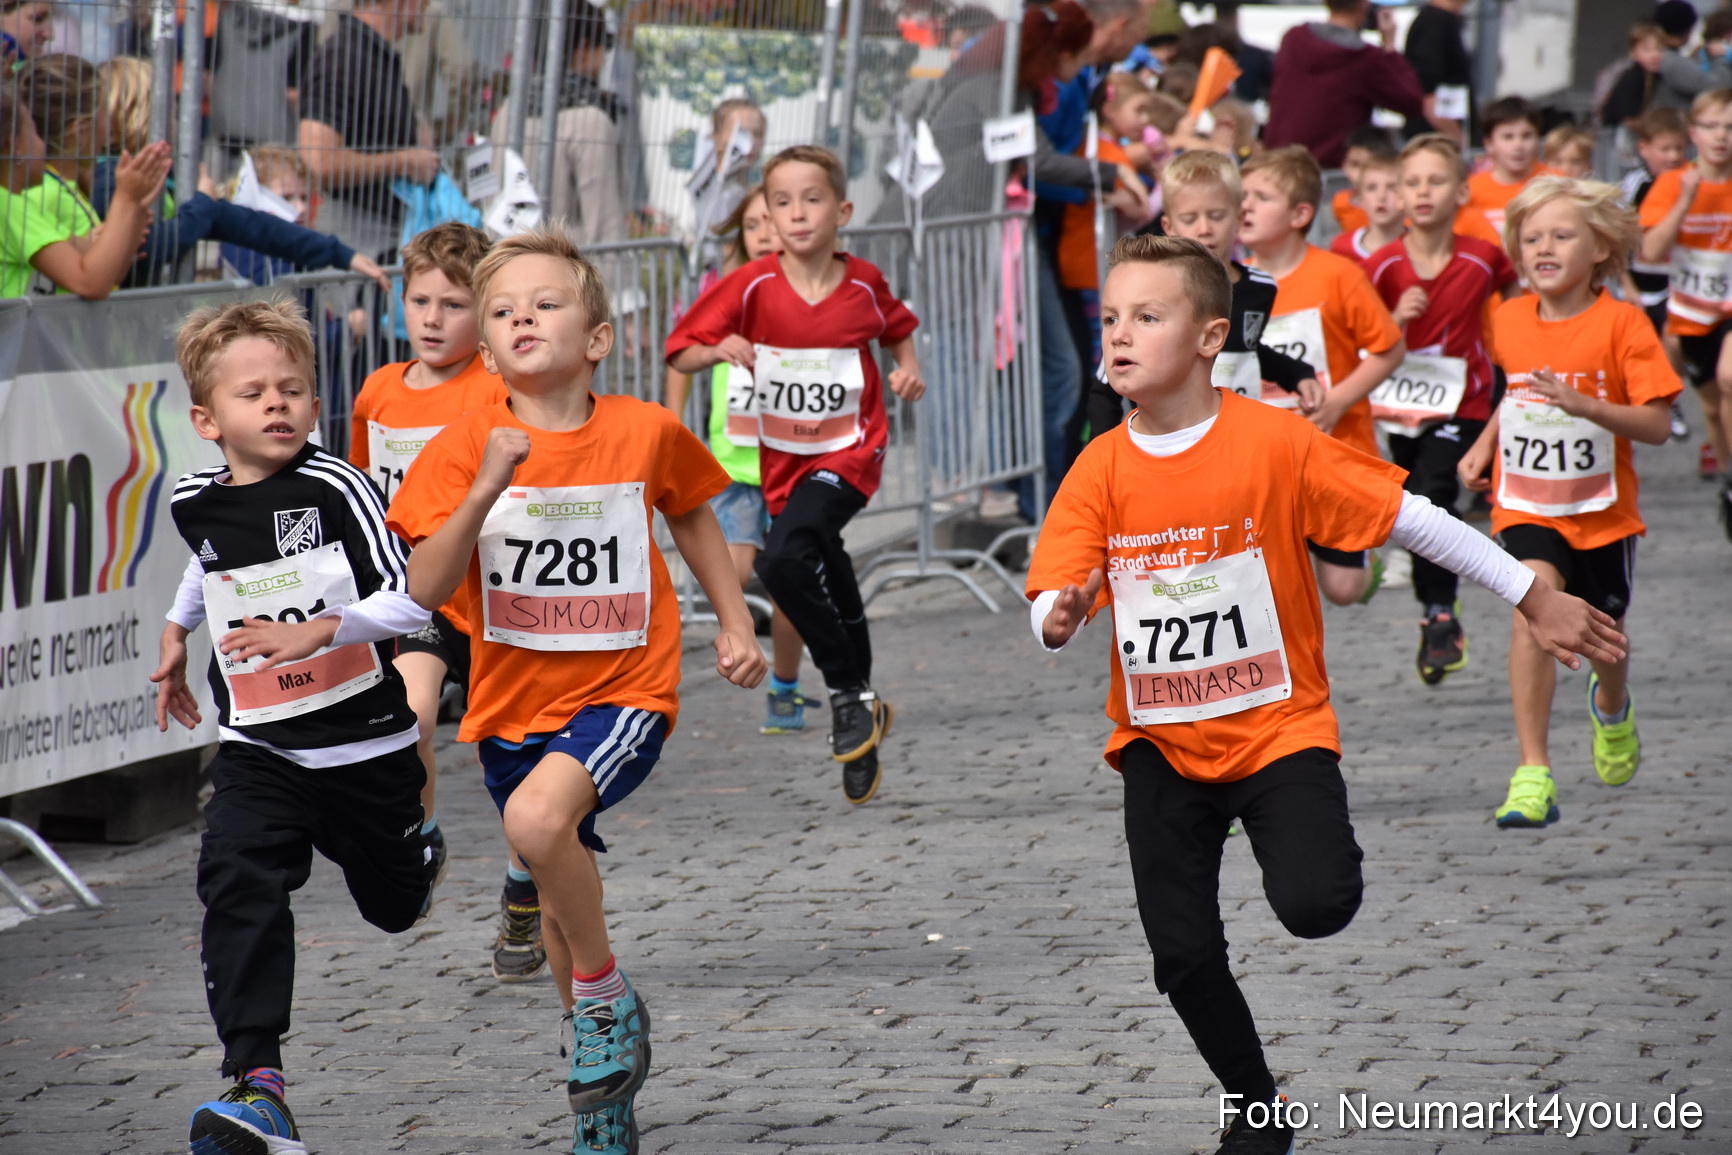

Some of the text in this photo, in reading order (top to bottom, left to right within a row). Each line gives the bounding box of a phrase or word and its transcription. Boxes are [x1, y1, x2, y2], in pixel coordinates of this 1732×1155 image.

[770, 380, 846, 413] 7039
[1380, 377, 1446, 407] 7020
[1514, 436, 1595, 472] 7213
[544, 501, 603, 517] BOCK
[1108, 527, 1205, 550] Neumarkter
[505, 536, 618, 586] 7281
[1109, 548, 1187, 571] Stadtlauf
[246, 571, 302, 595] BOCK
[1164, 575, 1219, 596] BOCK
[506, 592, 630, 629] SIMON
[50, 610, 140, 677] neumarkt
[1139, 605, 1247, 663] 7271
[278, 671, 315, 691] Max
[1137, 662, 1263, 705] LENNARD
[369, 714, 393, 725] climalite
